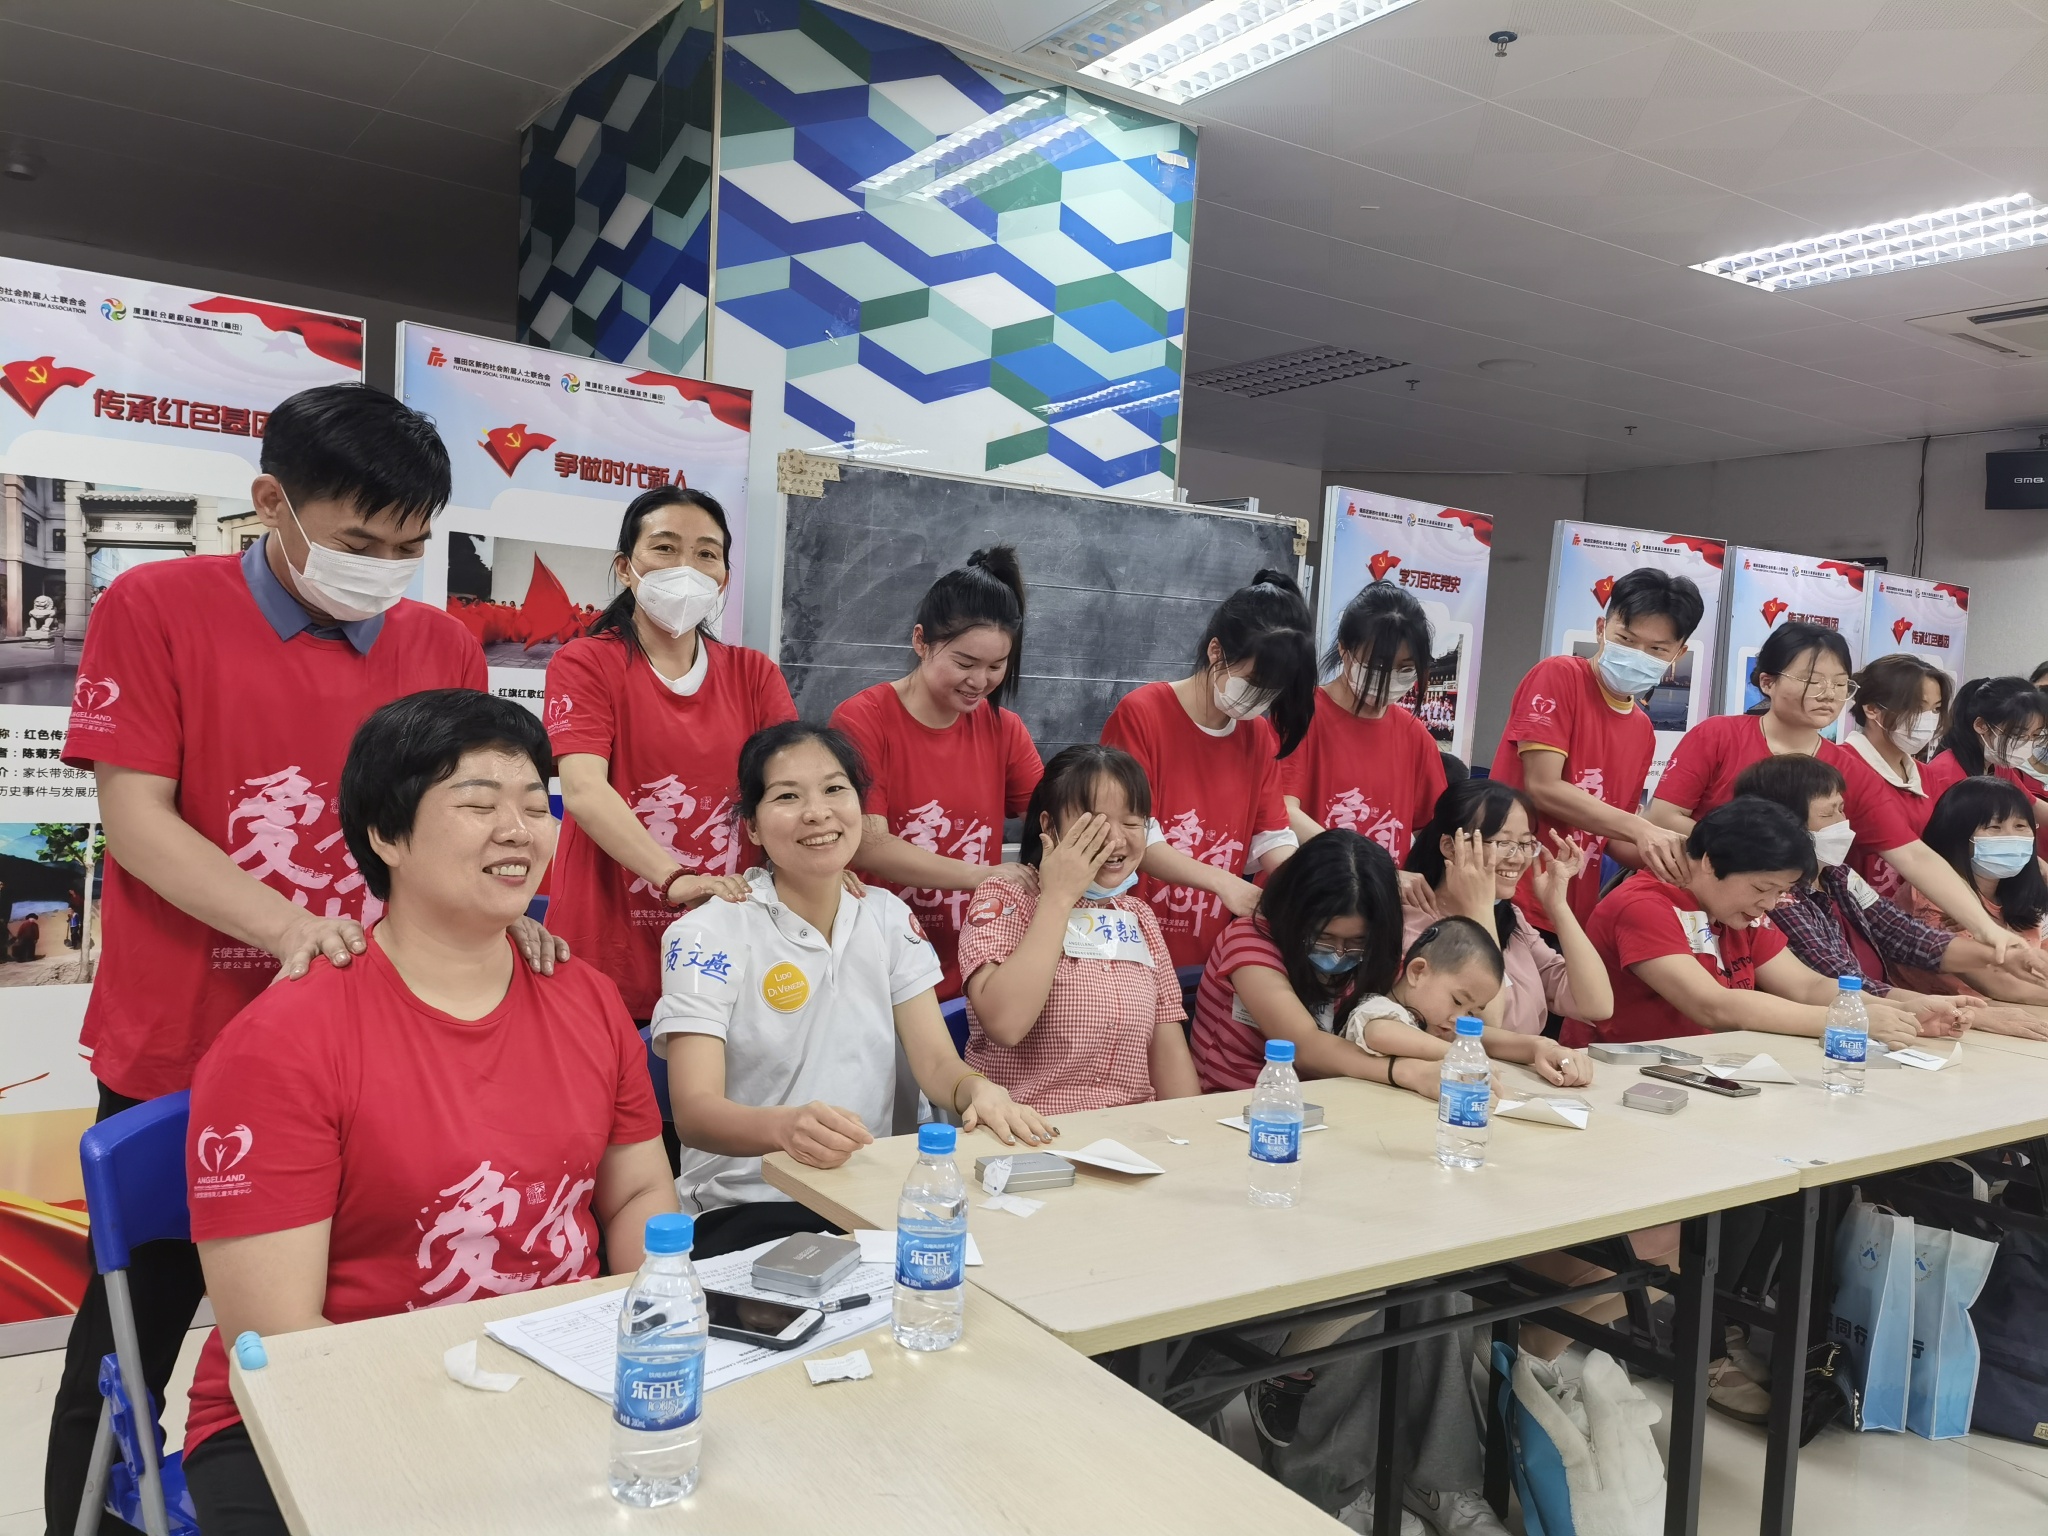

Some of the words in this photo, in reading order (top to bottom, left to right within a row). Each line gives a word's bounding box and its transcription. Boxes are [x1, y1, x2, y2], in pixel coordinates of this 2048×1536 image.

[18, 299, 47, 308] STRATUM
[47, 304, 87, 314] ASSOCIATION
[453, 365, 470, 373] FUTIAN
[499, 374, 521, 382] STRATUM
[521, 378, 551, 387] ASSOCIATION
[1399, 567, 1462, 594] 学习百年党史
[1911, 629, 1950, 649] 传承红色基因
[1257, 1131, 1290, 1145] 乐百氏
[197, 1173, 246, 1185] ANGELLAND
[909, 1249, 952, 1266] 乐百氏
[630, 1379, 686, 1400] 乐百氏
